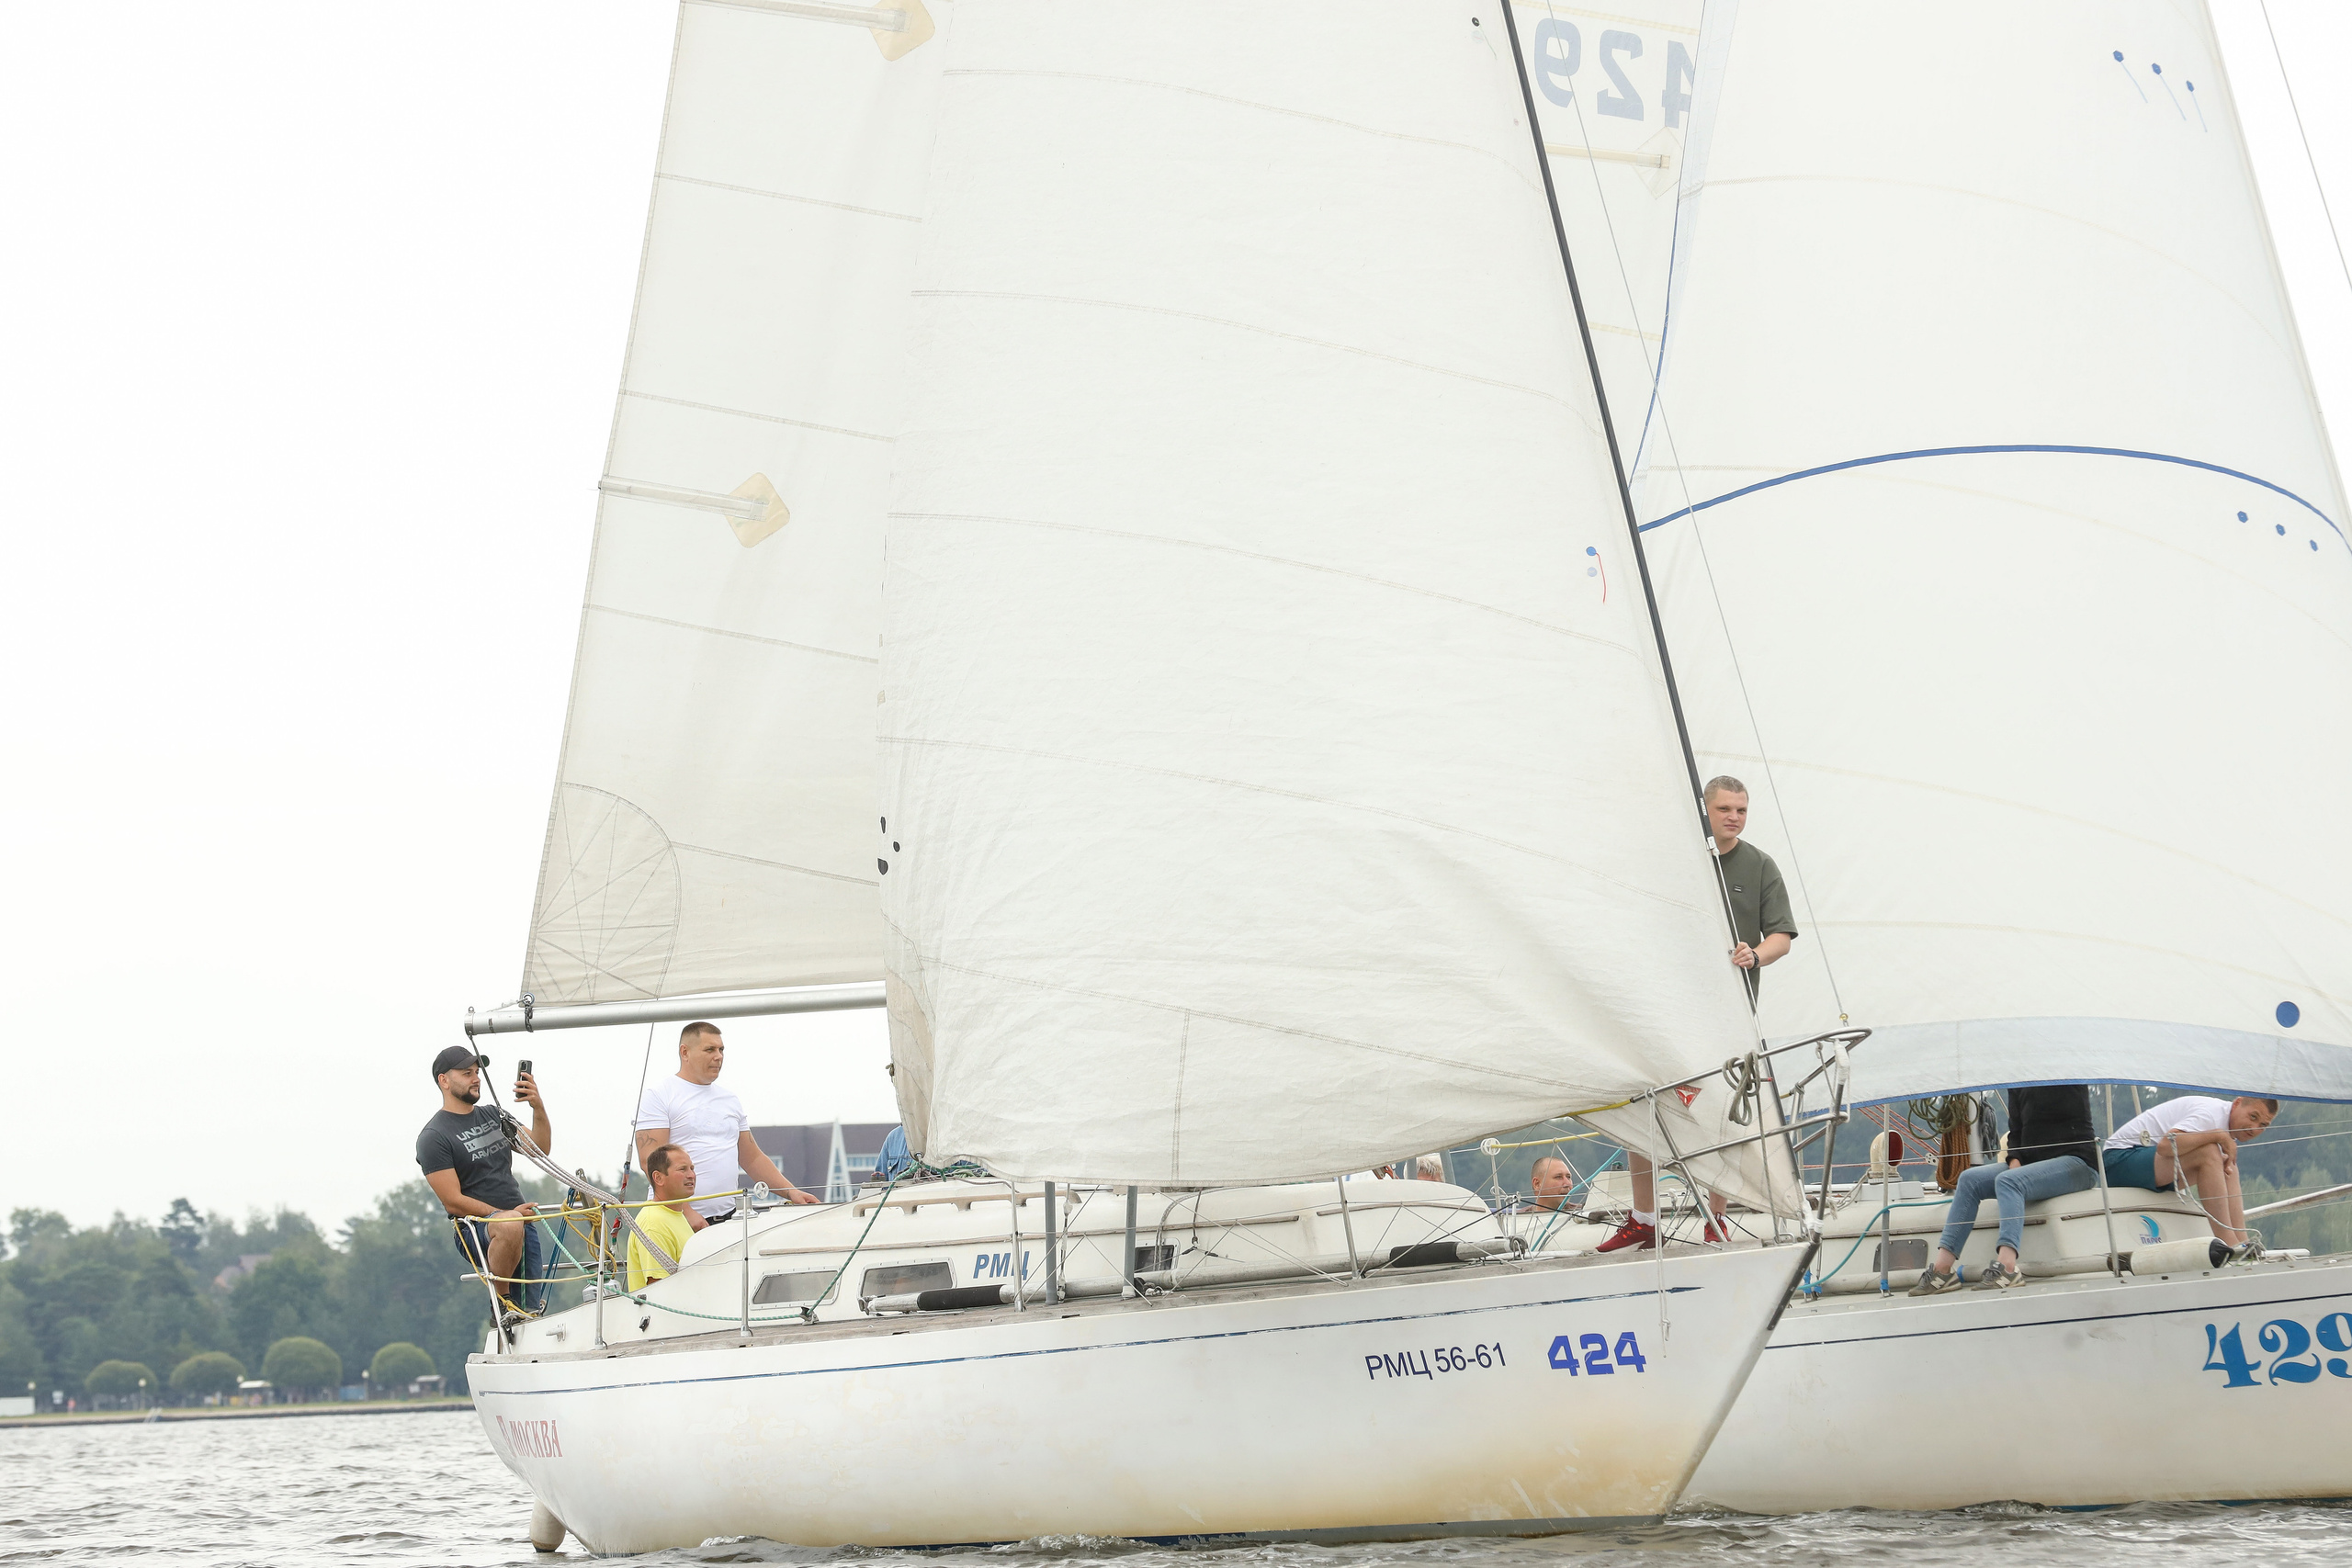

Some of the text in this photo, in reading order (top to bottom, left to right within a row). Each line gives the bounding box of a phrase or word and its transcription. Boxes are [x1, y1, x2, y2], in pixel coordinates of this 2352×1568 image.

[456, 1119, 499, 1142] UNDER
[1364, 1342, 1507, 1381] РМЦ 56-61
[1547, 1331, 1646, 1377] 424
[509, 1419, 563, 1458] МОСКВА
